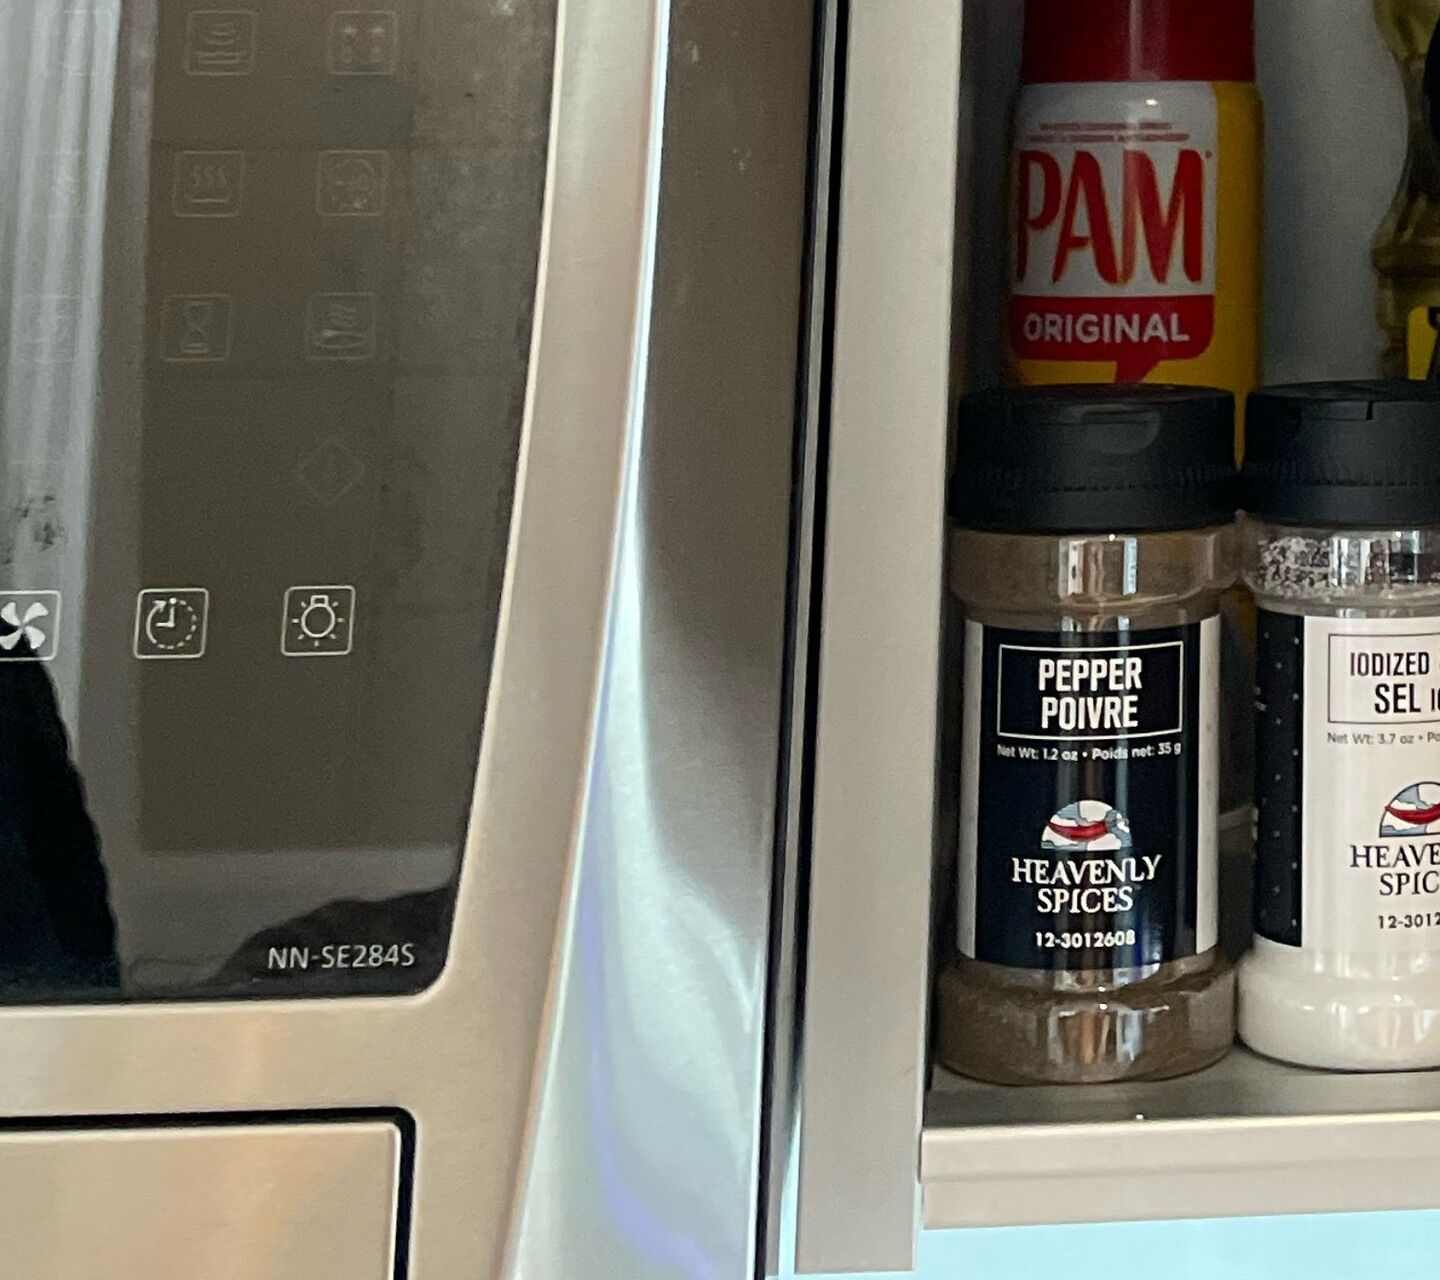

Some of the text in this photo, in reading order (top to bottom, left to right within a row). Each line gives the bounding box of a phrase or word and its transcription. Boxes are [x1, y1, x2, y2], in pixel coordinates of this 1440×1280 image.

[1016, 149, 1204, 284] PAM
[1023, 313, 1191, 344] ORIGINAL
[1038, 657, 1142, 692] PEPPER
[1350, 652, 1429, 676] IODIZED
[1041, 695, 1139, 730] POIVRE
[1375, 683, 1421, 714] SEL
[997, 744, 1015, 758] Net
[1061, 750, 1078, 761] oz
[1092, 747, 1128, 760] Poids
[1327, 732, 1348, 744] Net
[1011, 855, 1163, 885] HEAVENLY
[1037, 886, 1134, 914] SPICES
[1035, 931, 1135, 949] 12-3012608
[267, 943, 416, 969] NN-SE284S
